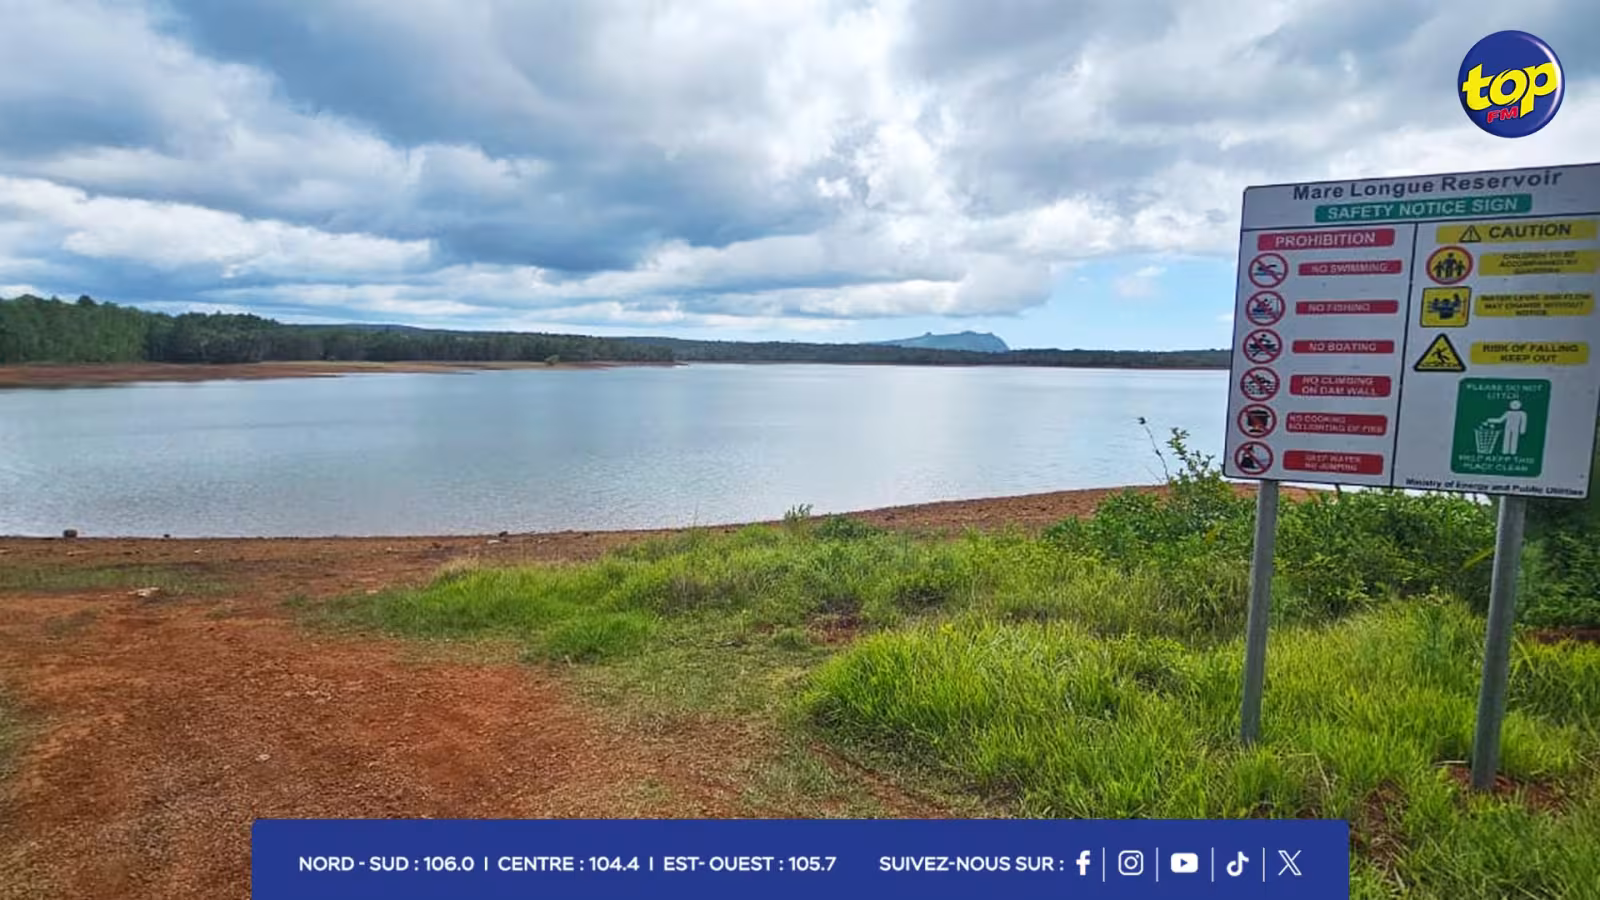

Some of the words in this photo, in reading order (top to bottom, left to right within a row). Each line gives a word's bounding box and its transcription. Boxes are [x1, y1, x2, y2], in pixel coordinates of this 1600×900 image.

[1293, 185, 1344, 200] Mare
[1350, 180, 1434, 198] Longue
[1441, 170, 1563, 191] Reservoir
[1328, 205, 1394, 220] SAFETY
[1399, 201, 1466, 216] NOTICE
[1471, 198, 1518, 213] SIGN
[1488, 223, 1572, 239] CAUTION
[1275, 232, 1376, 248] PROHIBITION
[1311, 265, 1328, 274] NO
[1330, 262, 1388, 274] SWIMMING
[1308, 303, 1324, 312] NO
[1326, 303, 1371, 312] FISHING
[1309, 343, 1325, 351] NO
[1328, 343, 1377, 352] BOATING
[1483, 344, 1508, 352] RISK
[1510, 344, 1527, 352] OF
[1529, 344, 1579, 352] FALLING
[1500, 354, 1530, 362] KEEP
[1532, 354, 1558, 362] OUT
[1302, 376, 1319, 386] NO
[1321, 376, 1374, 386] CLIMBING
[1302, 386, 1318, 395] ON
[1320, 386, 1345, 395] DAM
[1347, 387, 1377, 396] WALL
[1289, 415, 1303, 423] NO
[1405, 478, 1441, 489] Ministry
[1444, 479, 1455, 488] of
[1456, 481, 1489, 491] Energy
[1491, 483, 1511, 491] and
[1512, 484, 1544, 494] Public
[1545, 486, 1584, 496] Utilities
